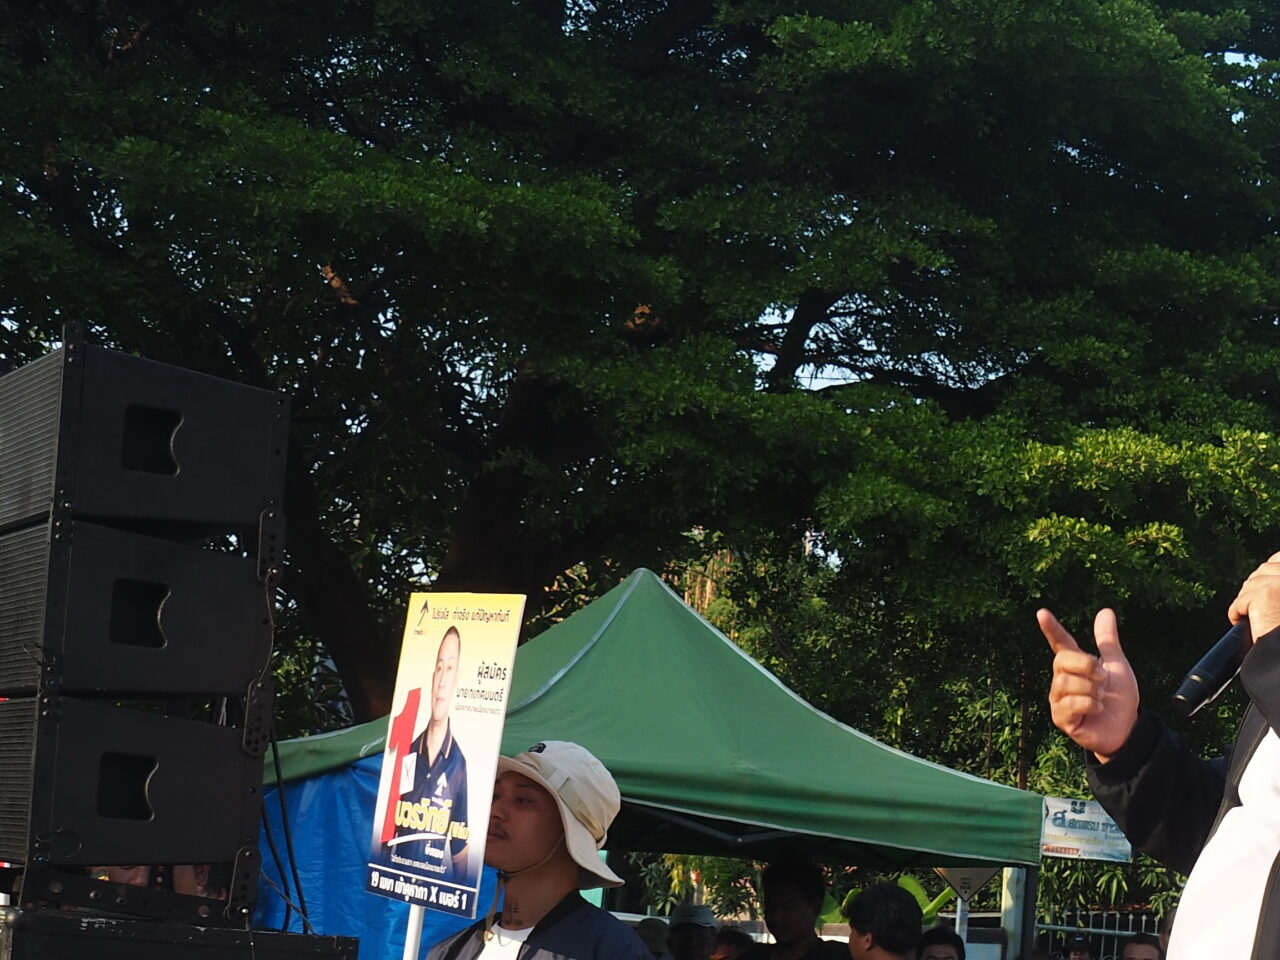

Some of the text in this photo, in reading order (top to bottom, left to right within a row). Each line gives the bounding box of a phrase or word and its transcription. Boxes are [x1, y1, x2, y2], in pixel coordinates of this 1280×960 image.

[477, 660, 507, 685] ผู้สมัคร
[456, 687, 504, 702] นายกเทศมนตรี
